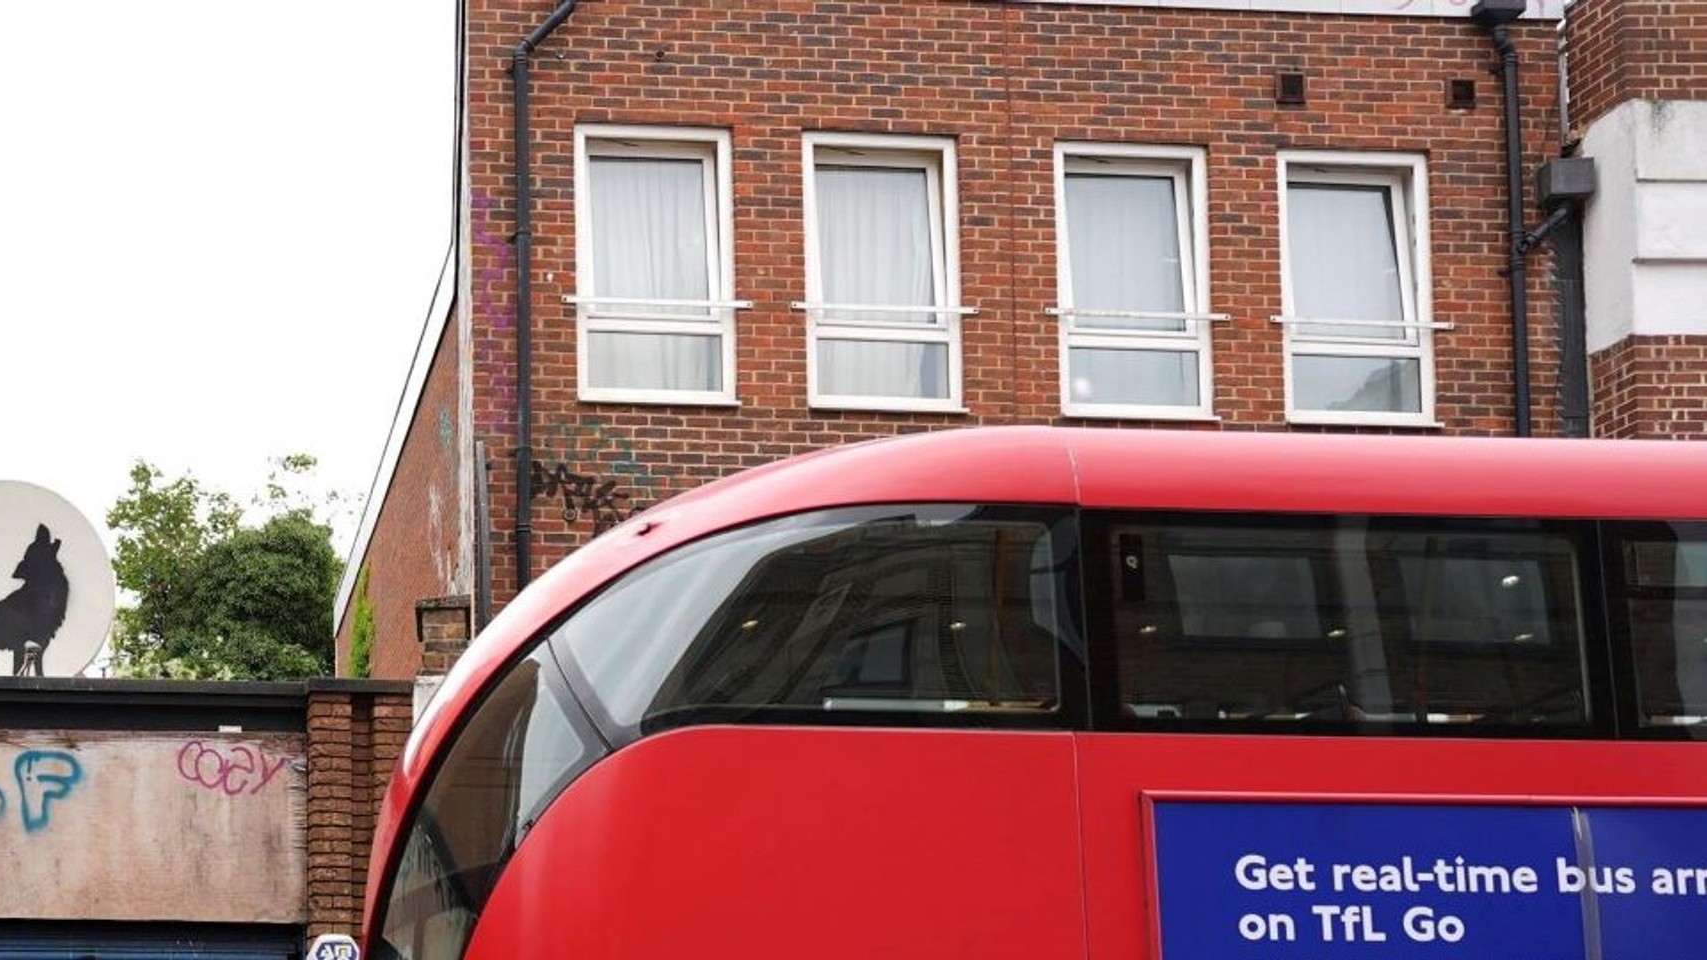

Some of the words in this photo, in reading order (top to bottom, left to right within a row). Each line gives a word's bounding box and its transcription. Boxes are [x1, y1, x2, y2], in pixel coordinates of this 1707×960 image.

[1235, 855, 1316, 891] Get
[1333, 857, 1538, 893] real-time
[1556, 857, 1636, 893] bus
[1238, 913, 1295, 942] on
[1312, 905, 1386, 942] TfL
[1403, 906, 1465, 943] Go
